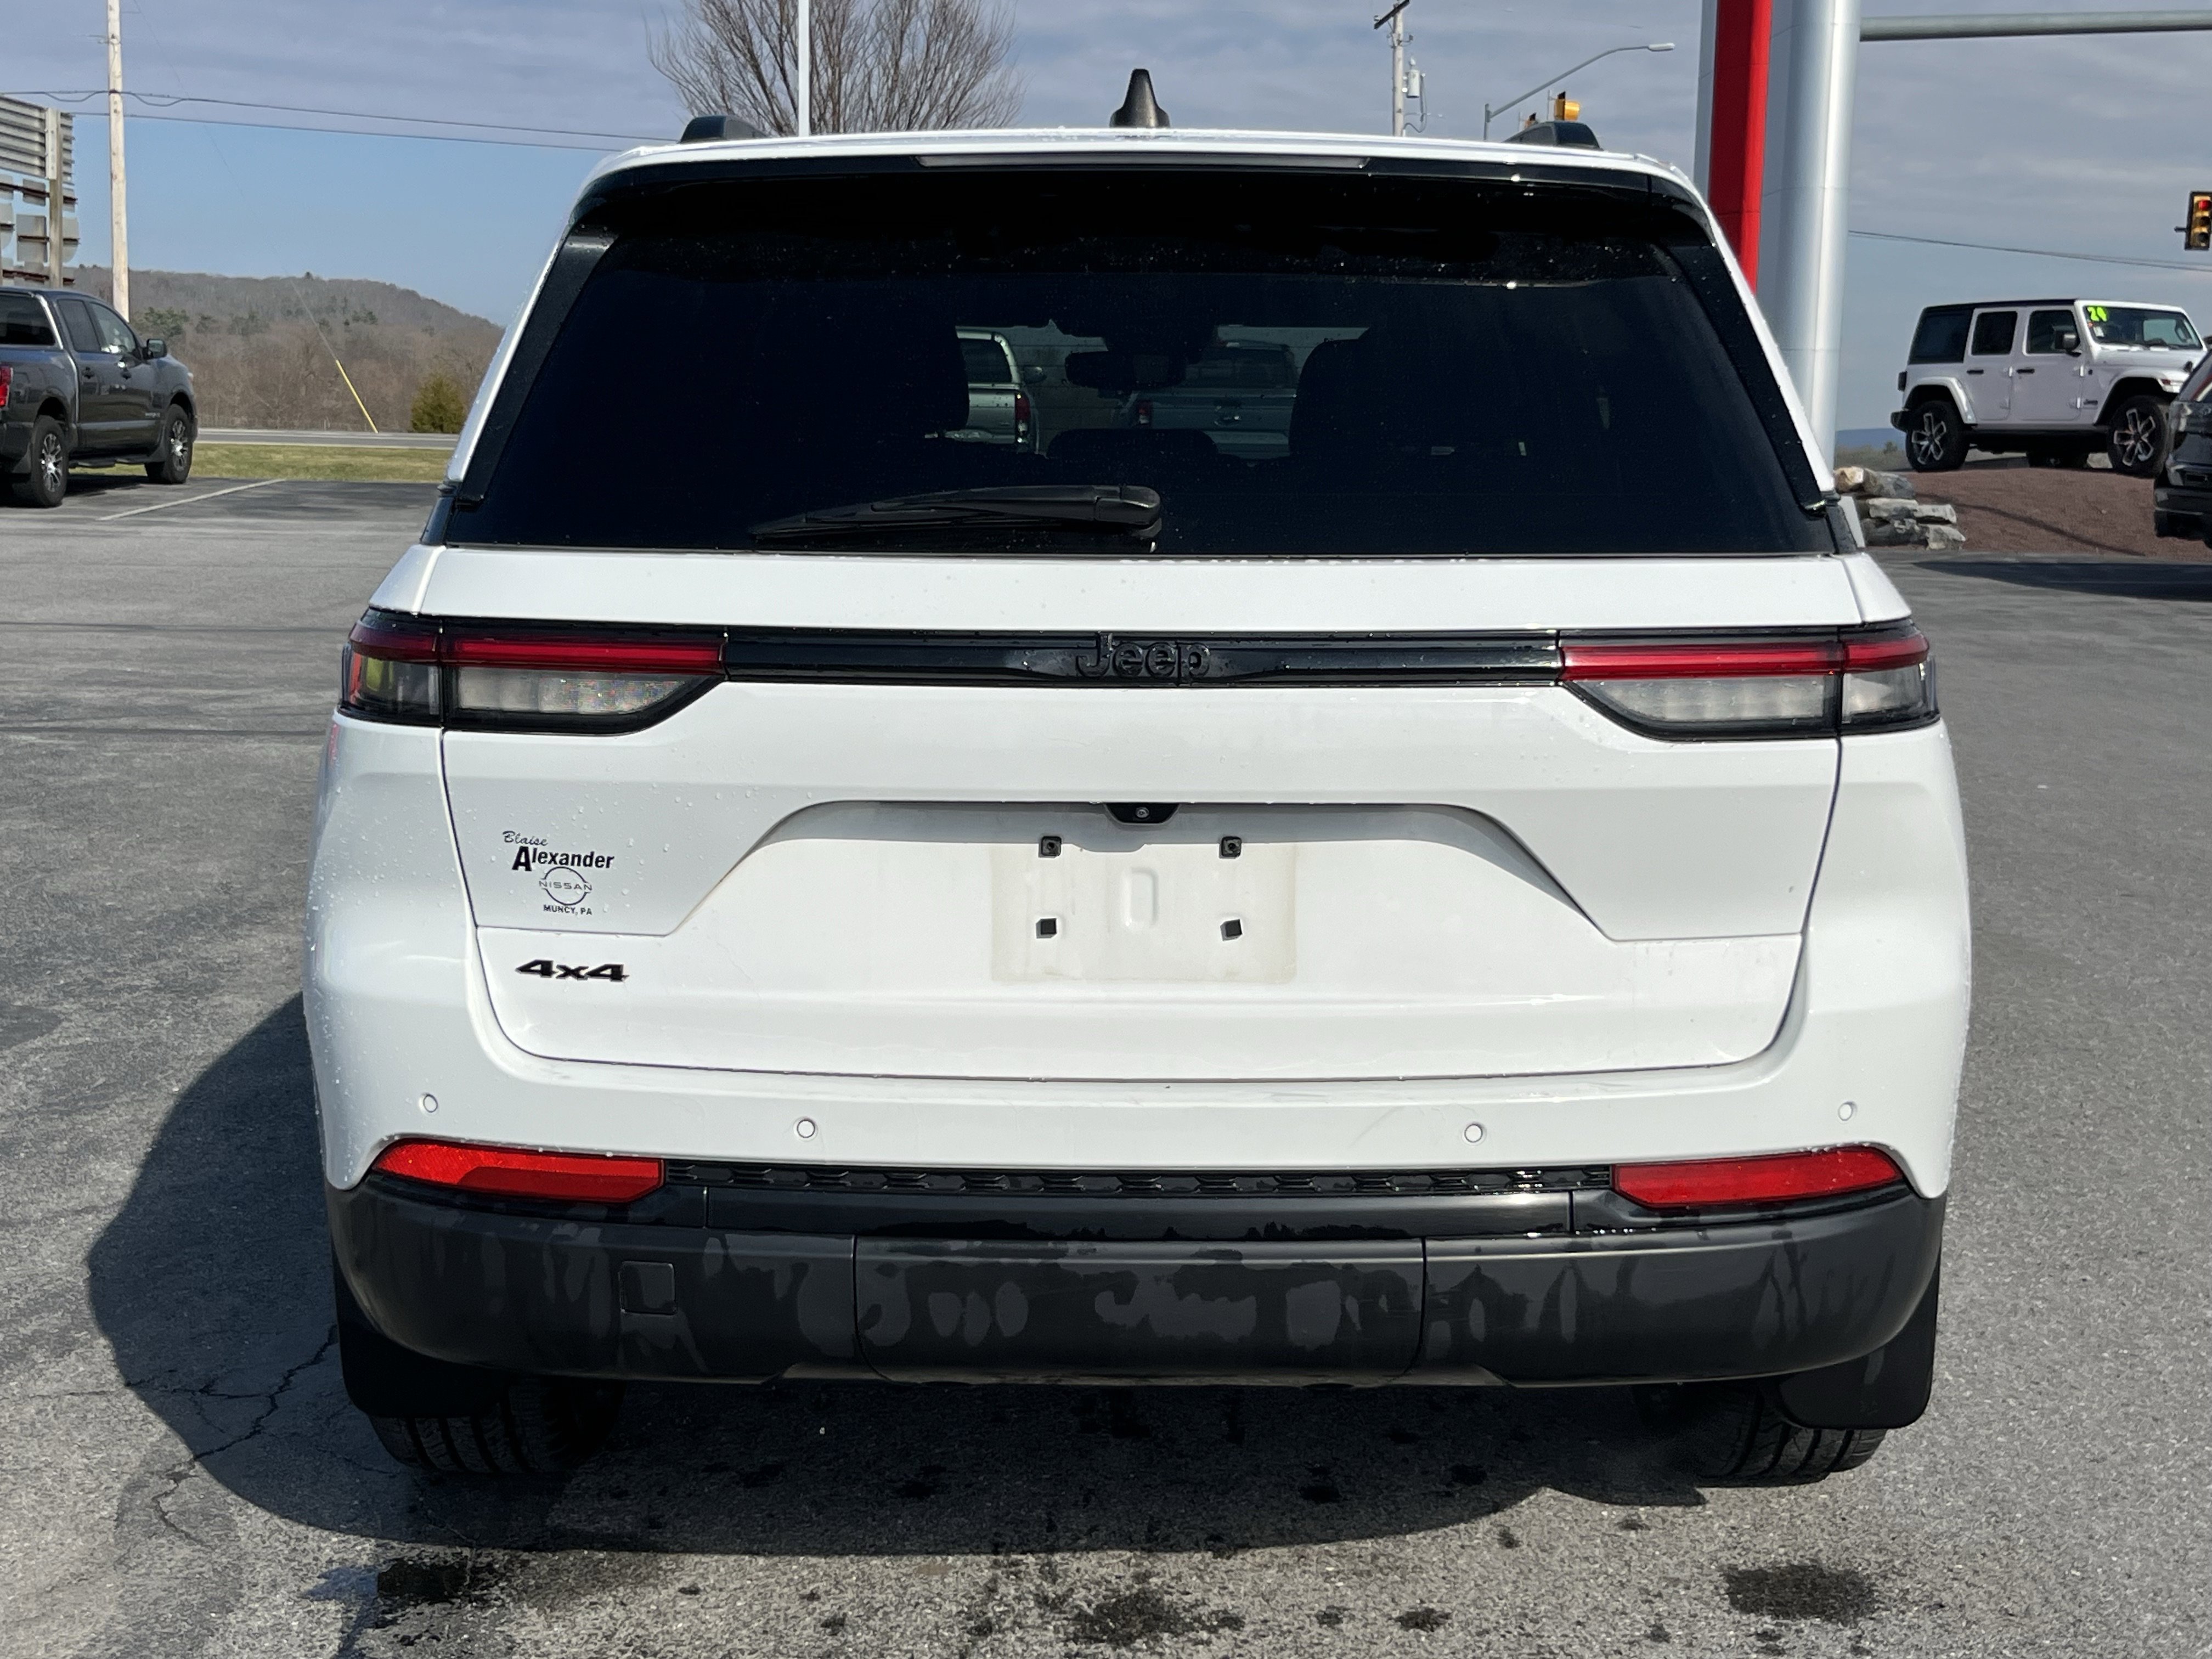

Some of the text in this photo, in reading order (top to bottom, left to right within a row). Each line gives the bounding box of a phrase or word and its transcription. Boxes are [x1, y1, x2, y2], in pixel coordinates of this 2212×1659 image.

[1075, 631, 1209, 686] Jeep
[503, 831, 549, 846] Blaise
[512, 845, 615, 871] Alexander
[539, 881, 592, 891] NISSAN
[543, 905, 579, 916] MUNCY,
[515, 959, 629, 981] 4x4
